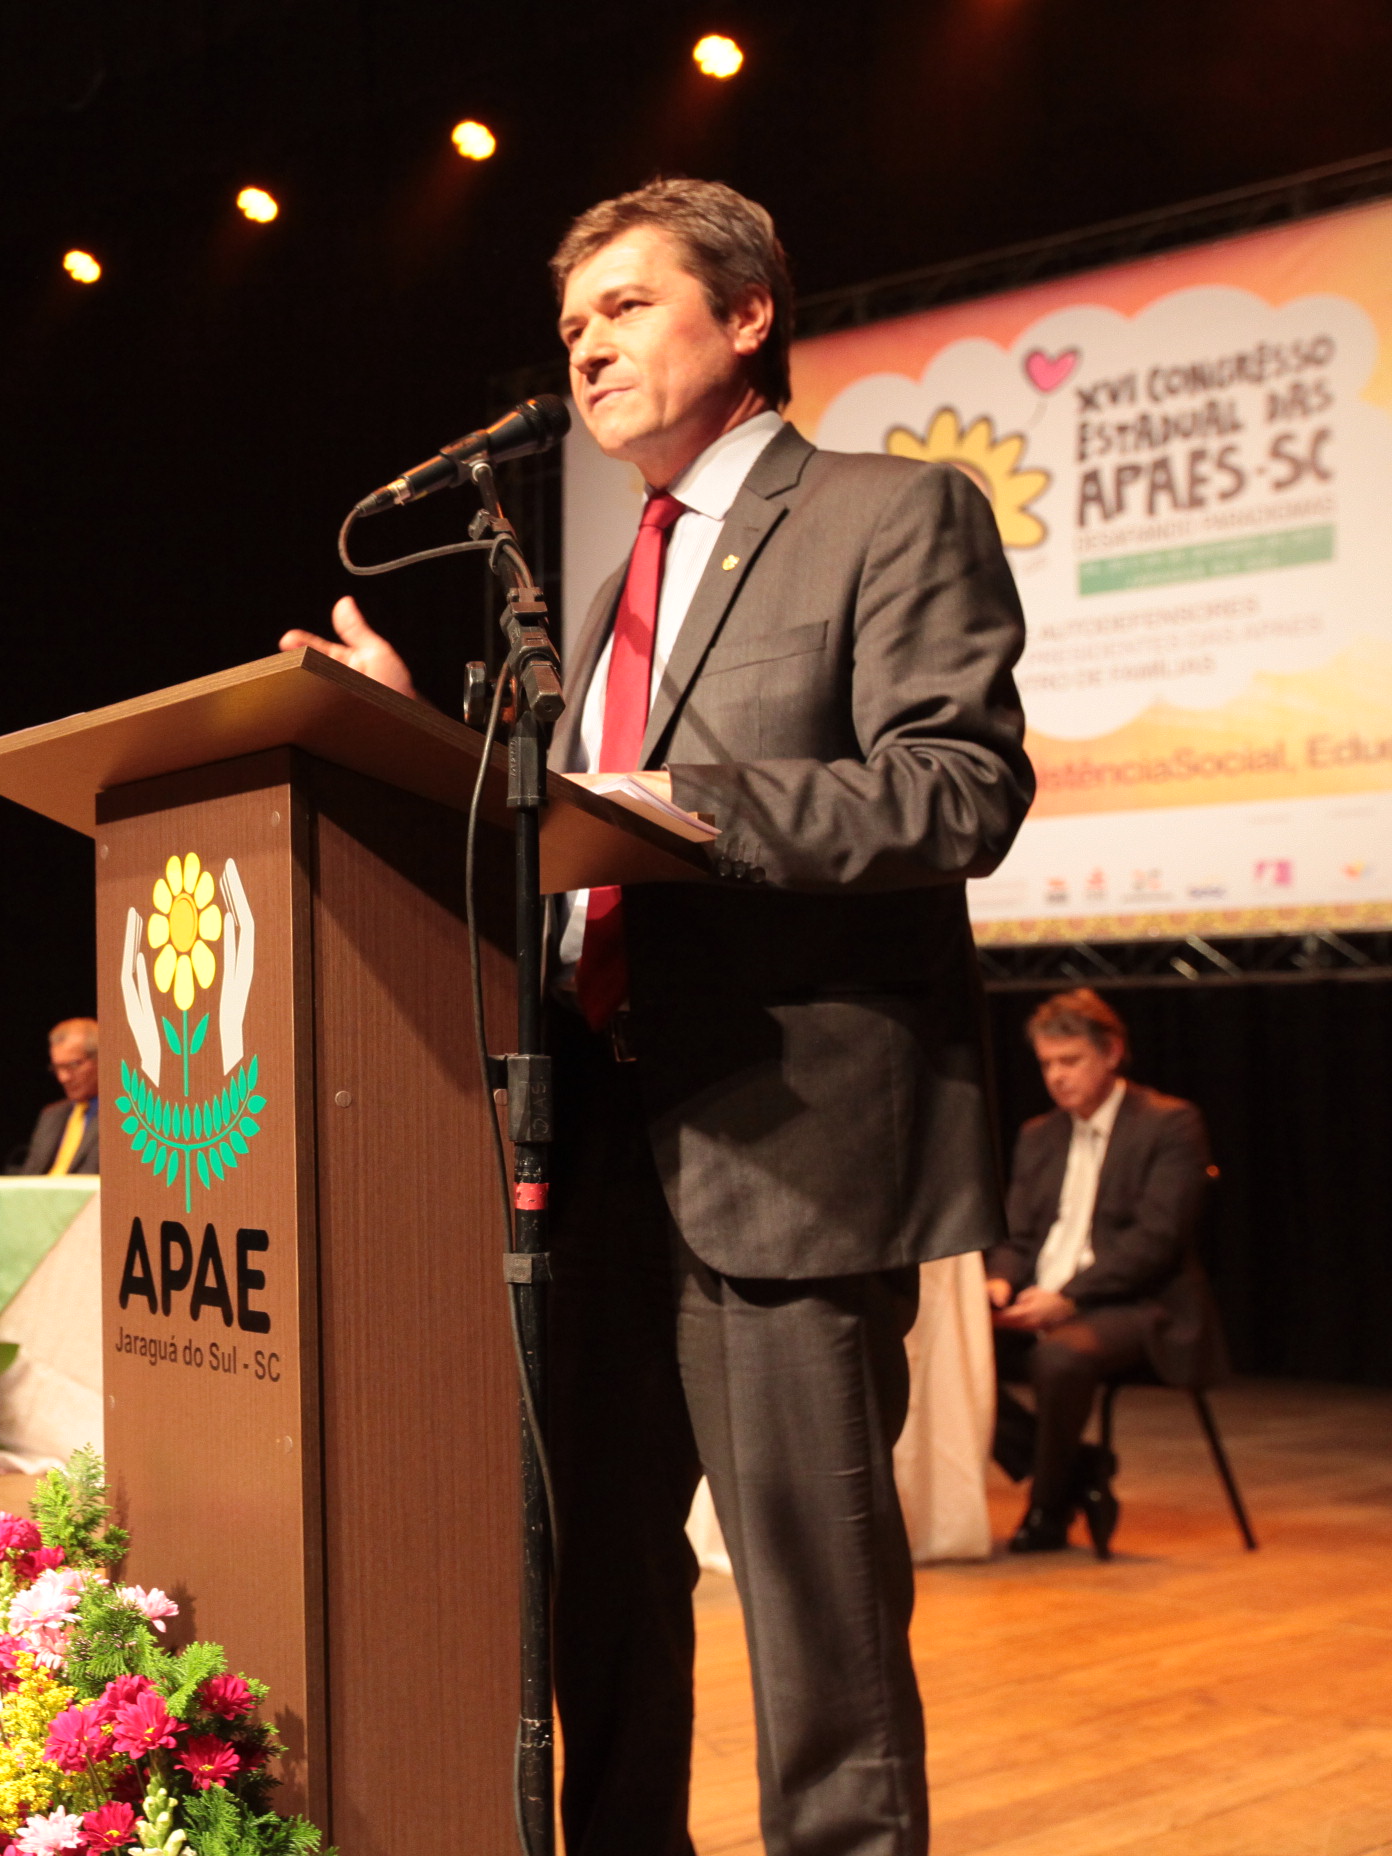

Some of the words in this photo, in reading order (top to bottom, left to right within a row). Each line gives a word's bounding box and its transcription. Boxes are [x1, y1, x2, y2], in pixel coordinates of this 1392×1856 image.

[1147, 334, 1337, 402] CONGRESSO
[1077, 399, 1244, 463] ESTADUAL
[1266, 378, 1336, 423] DAS
[1306, 731, 1392, 771] Edu
[119, 1216, 270, 1334] APAE
[115, 1326, 178, 1366] Jaraguá
[184, 1339, 204, 1367] do
[210, 1343, 236, 1374] Sul
[255, 1351, 280, 1382] SC
